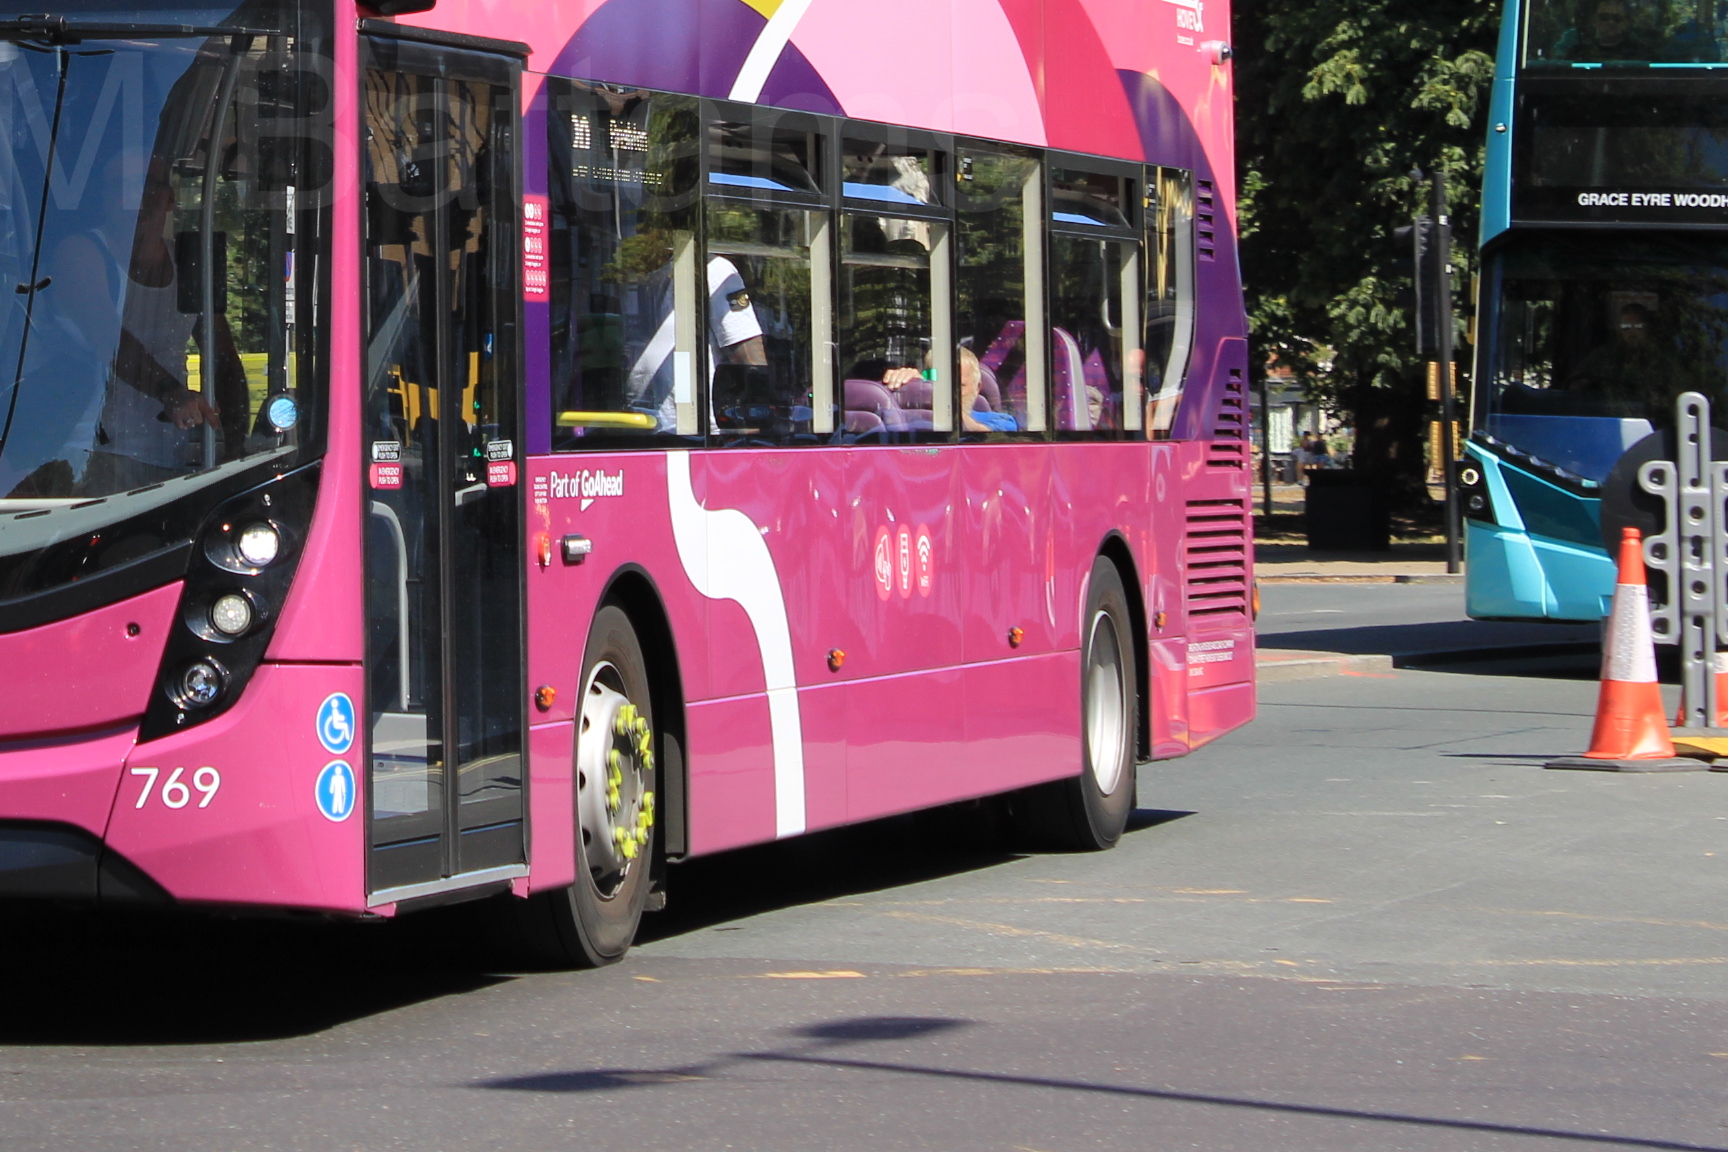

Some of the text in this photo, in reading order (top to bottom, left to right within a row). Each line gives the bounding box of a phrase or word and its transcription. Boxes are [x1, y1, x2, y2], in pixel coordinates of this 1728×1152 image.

[1577, 192, 1628, 207] GRACE
[1631, 192, 1671, 207] EYRE
[550, 470, 569, 498] Part
[569, 469, 580, 497] of
[581, 469, 623, 497] GoAhead
[130, 765, 221, 810] 769
